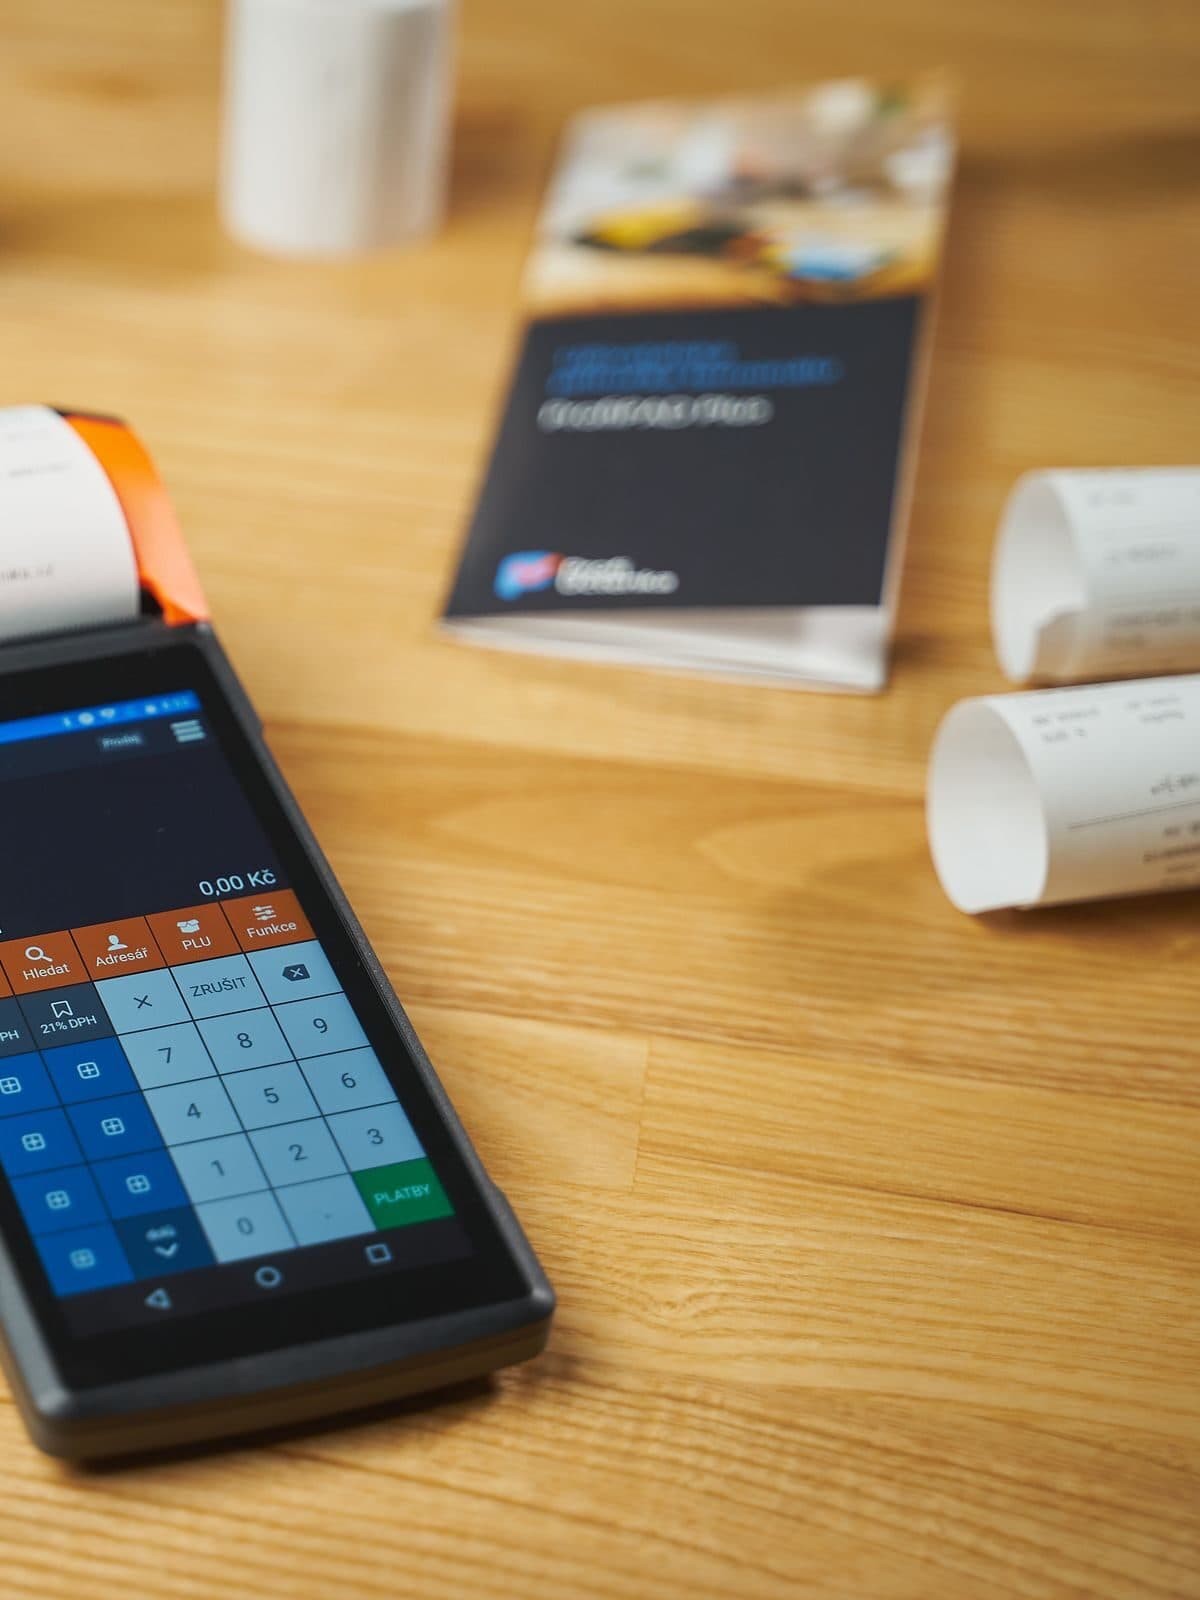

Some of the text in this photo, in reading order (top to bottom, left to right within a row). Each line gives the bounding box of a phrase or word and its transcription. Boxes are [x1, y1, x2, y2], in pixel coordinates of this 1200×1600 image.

[199, 868, 277, 896] 0,00 Kč
[246, 922, 297, 938] Funkce
[181, 936, 211, 950] PLU
[95, 946, 148, 967] Adresář
[22, 963, 71, 980] Hledat
[189, 976, 247, 997] ZRUŠIT
[40, 1015, 97, 1034] 21% DPH
[313, 1018, 328, 1034] 9
[237, 1032, 253, 1048] 8
[158, 1047, 172, 1063] 7
[341, 1073, 356, 1088] 6
[264, 1087, 279, 1104] 5
[187, 1103, 201, 1119] 4
[367, 1129, 383, 1145] 3
[289, 1144, 308, 1161] 2
[211, 1160, 225, 1176] 1
[374, 1183, 430, 1205] PLATBY
[236, 1217, 253, 1235] 0
